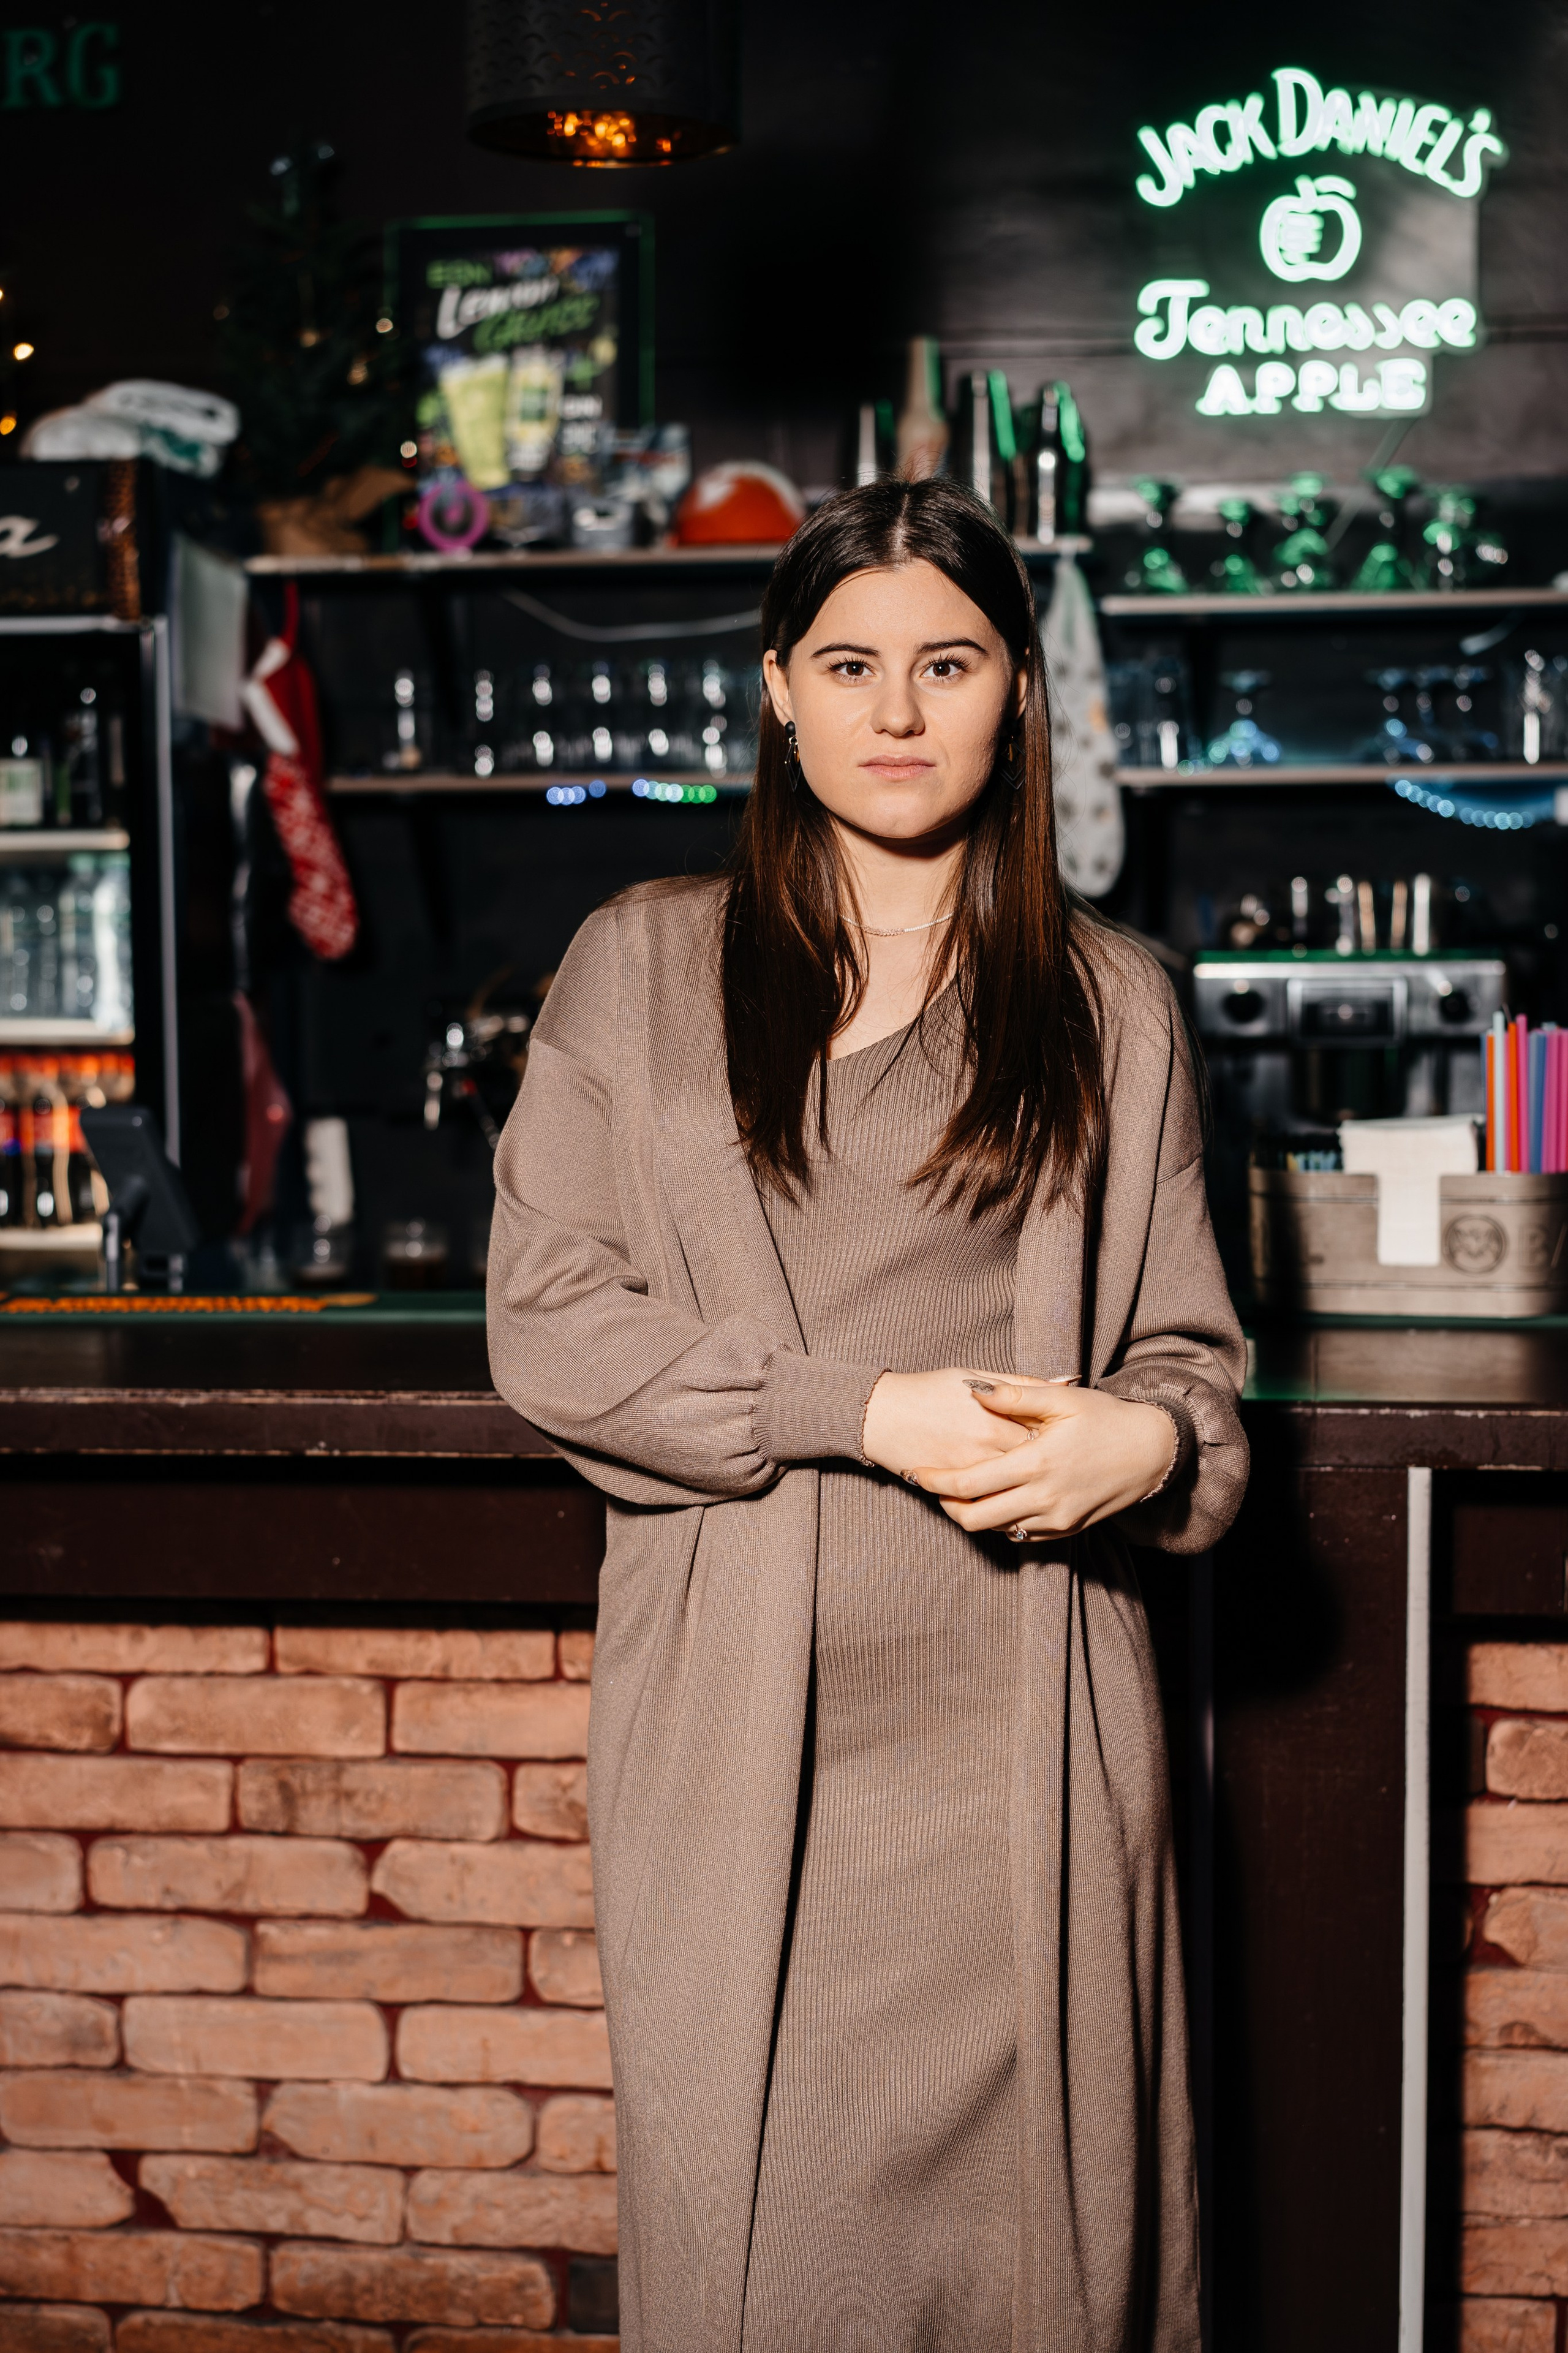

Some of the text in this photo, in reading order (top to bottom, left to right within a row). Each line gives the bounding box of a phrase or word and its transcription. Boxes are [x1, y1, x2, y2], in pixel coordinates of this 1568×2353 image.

[1136, 92, 1278, 207] JACK
[1134, 279, 1477, 360] Tennessee
[1195, 357, 1428, 416] APPLE
